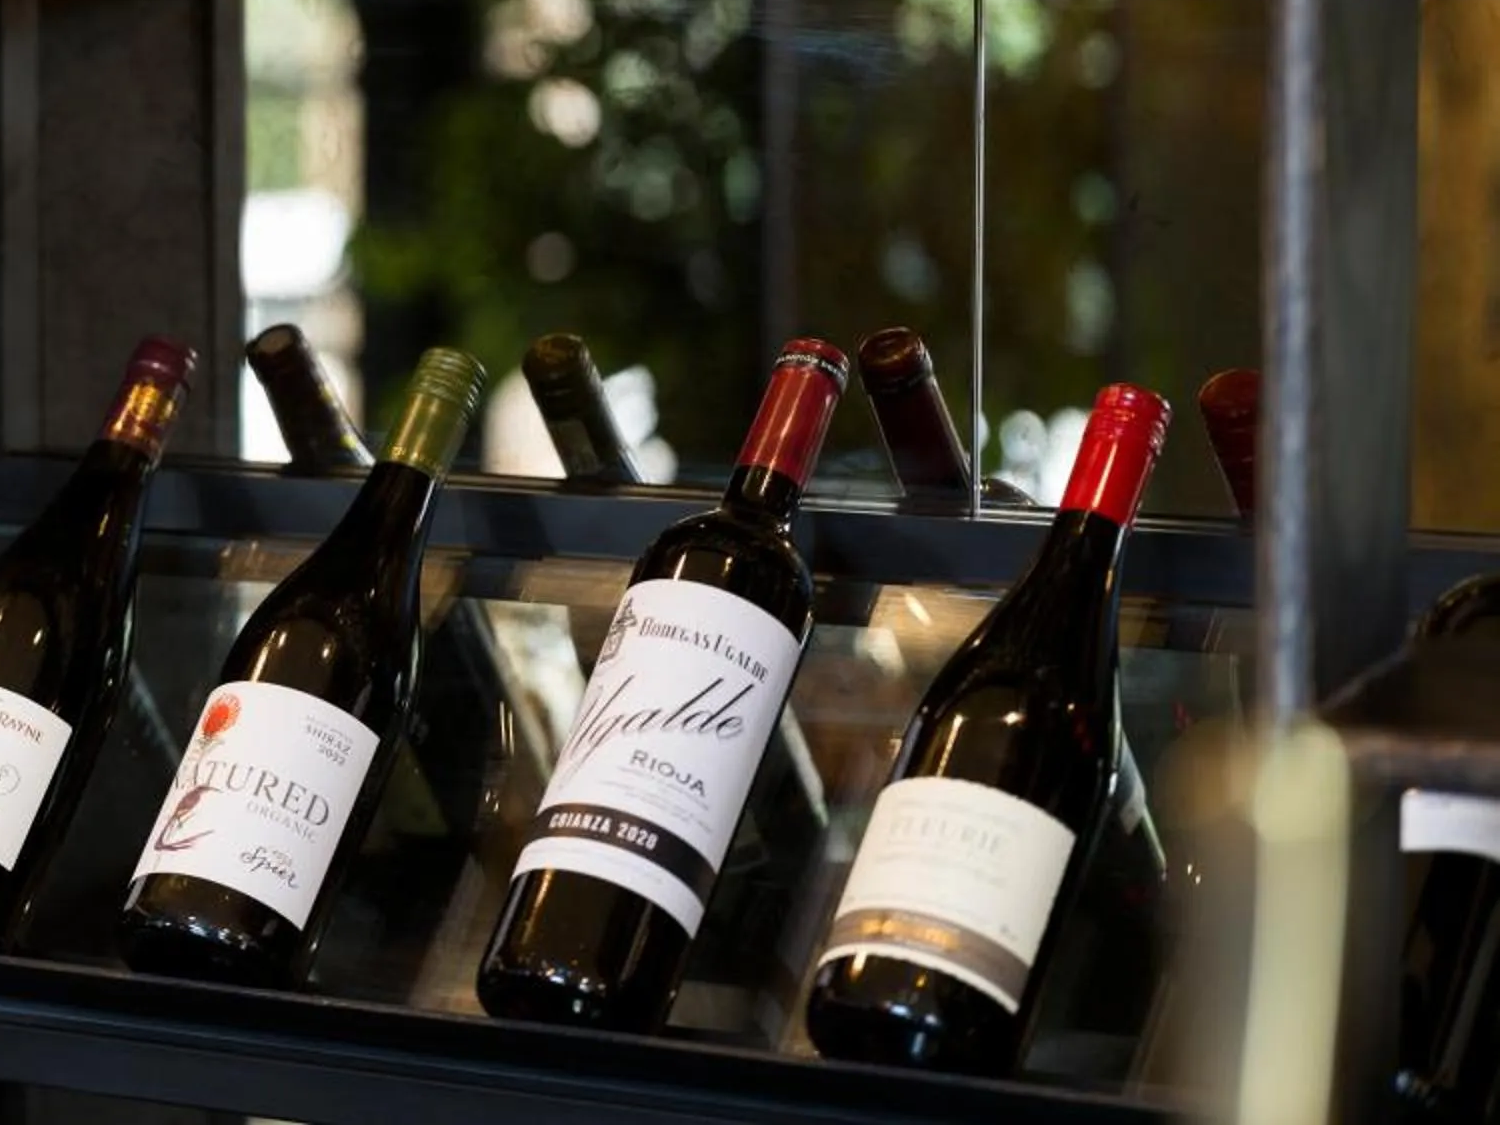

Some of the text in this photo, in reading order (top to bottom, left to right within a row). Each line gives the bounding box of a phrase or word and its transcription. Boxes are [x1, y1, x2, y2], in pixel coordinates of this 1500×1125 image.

[638, 617, 710, 653] BODEGAS
[630, 749, 708, 798] RIOJA
[548, 811, 660, 852] CRIANZA 2020
